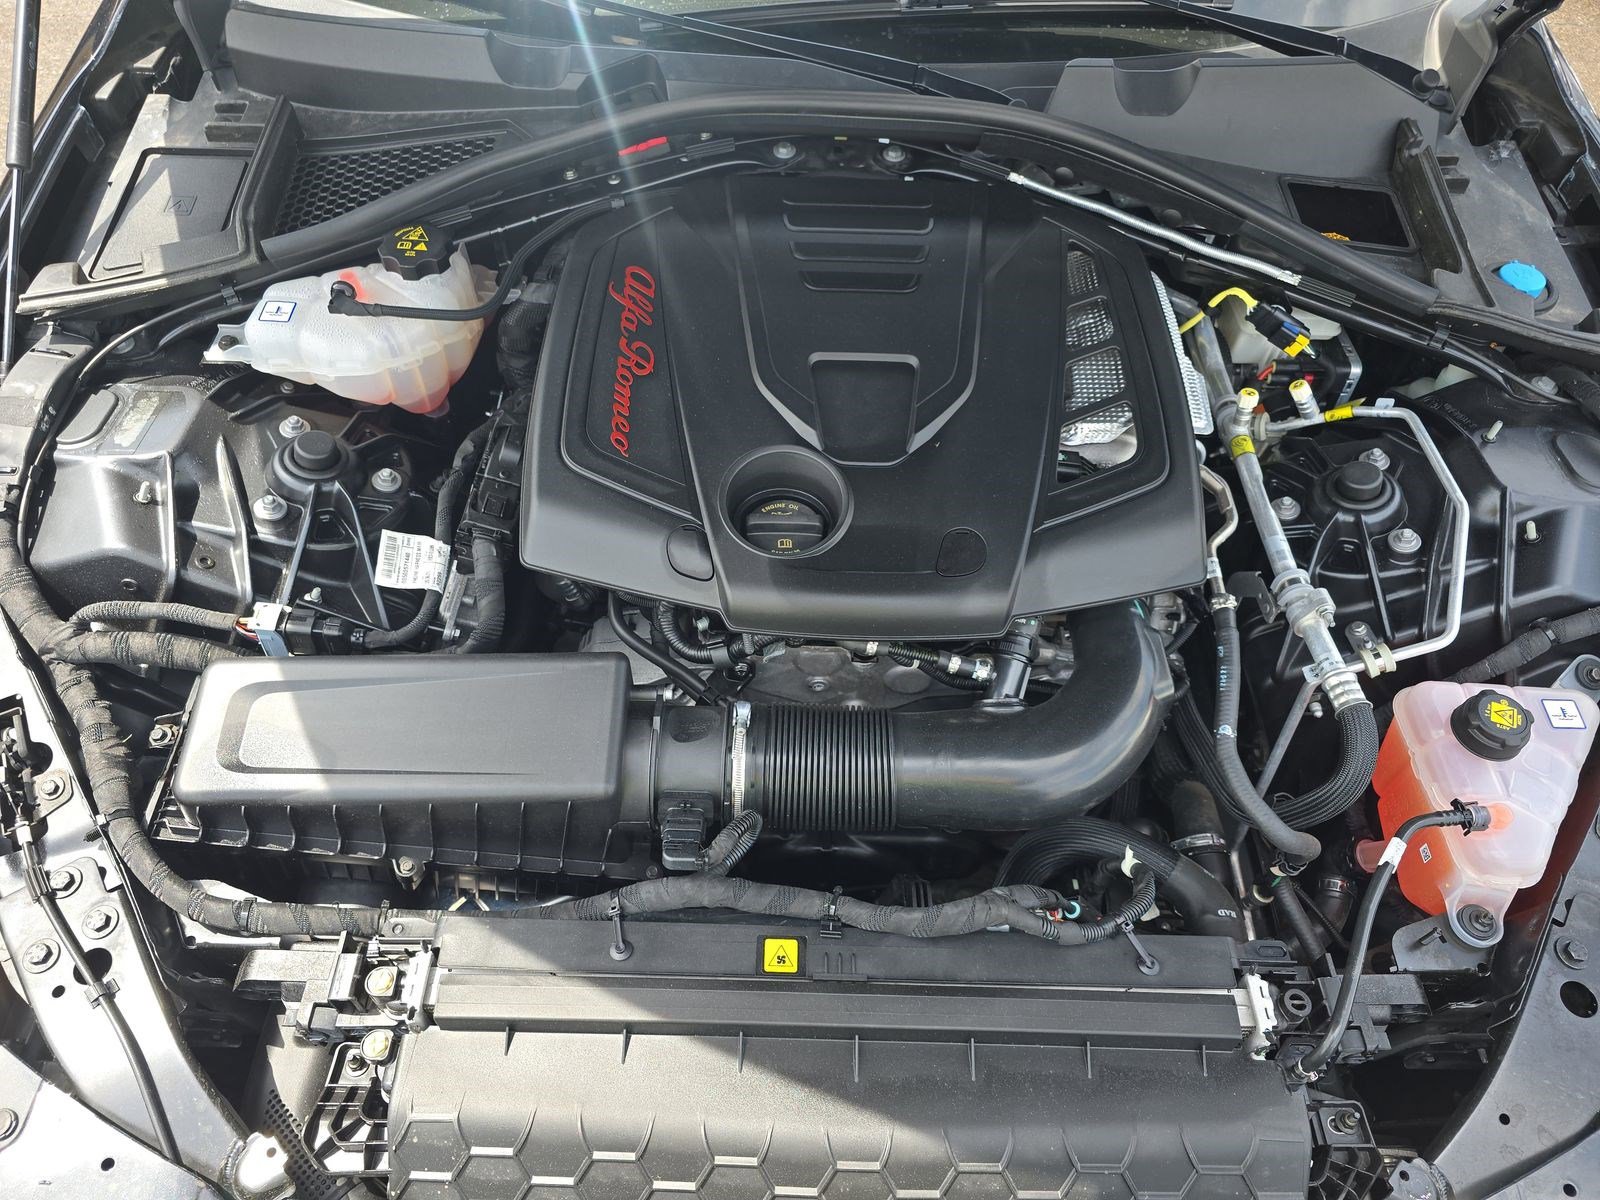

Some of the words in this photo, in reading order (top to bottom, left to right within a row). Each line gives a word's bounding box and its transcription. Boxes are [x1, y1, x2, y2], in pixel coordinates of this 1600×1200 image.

[608, 265, 656, 338] Alfa
[609, 335, 655, 457] Romeo
[761, 503, 785, 512] ENGINE
[788, 503, 799, 511] OIL
[1217, 909, 1237, 918] RAD
